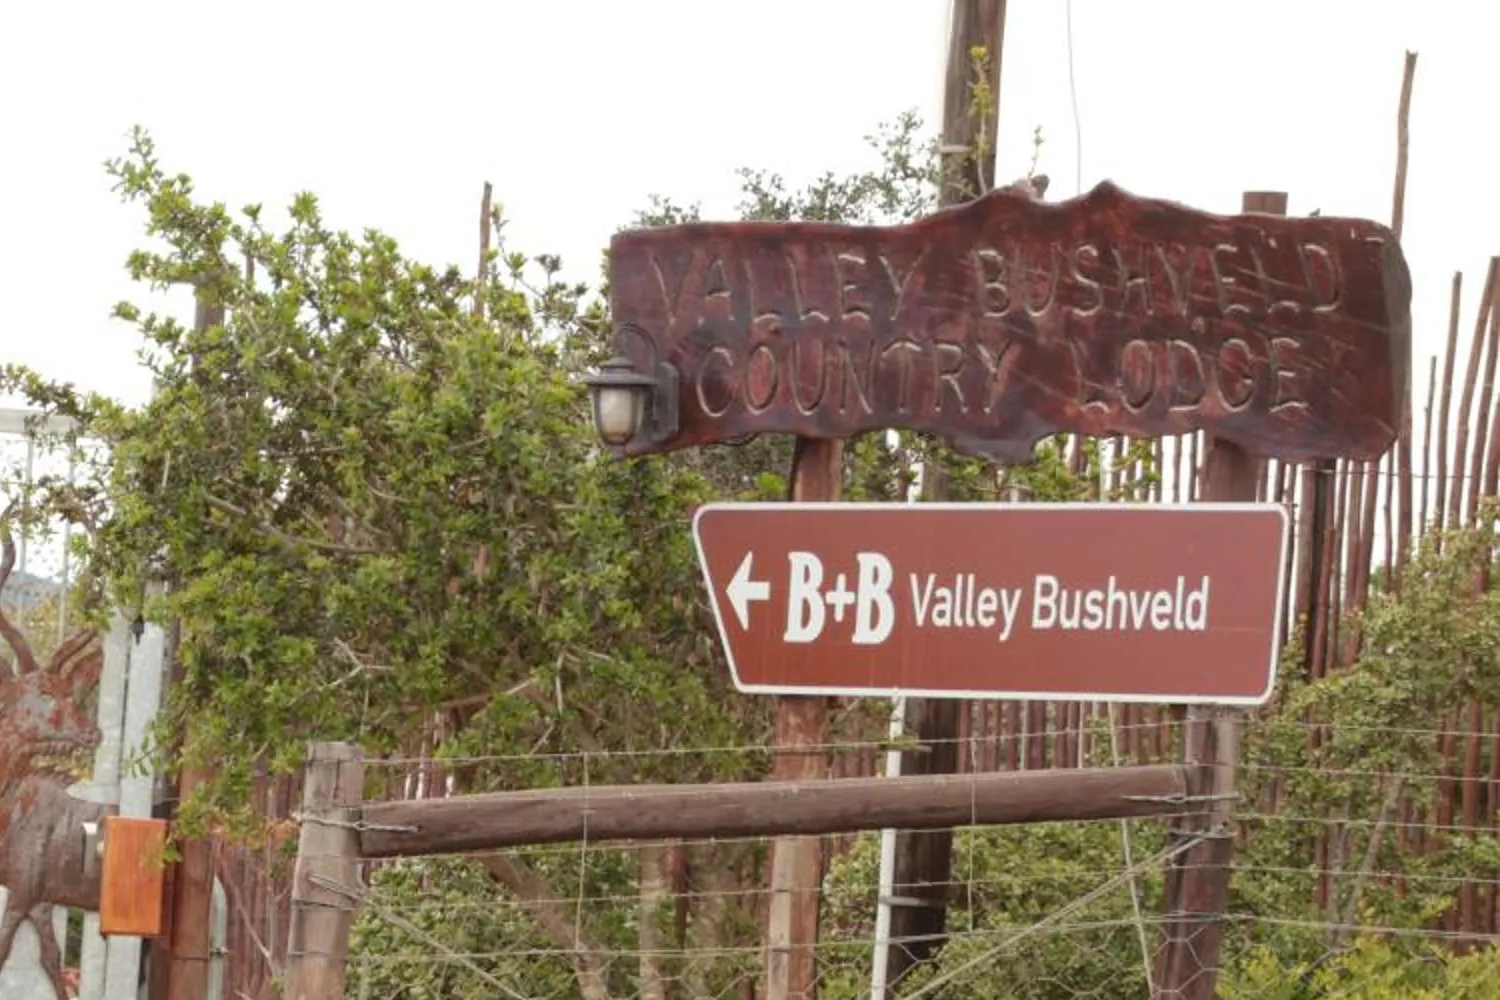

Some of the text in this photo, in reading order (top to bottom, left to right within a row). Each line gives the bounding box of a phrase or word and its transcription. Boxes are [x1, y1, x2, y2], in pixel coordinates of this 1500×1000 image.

[645, 243, 1344, 323] VALLEY BUSHVELD
[696, 336, 1310, 416] COUNTRY LODGE
[783, 551, 1210, 644] B+B Valley Bushveld
